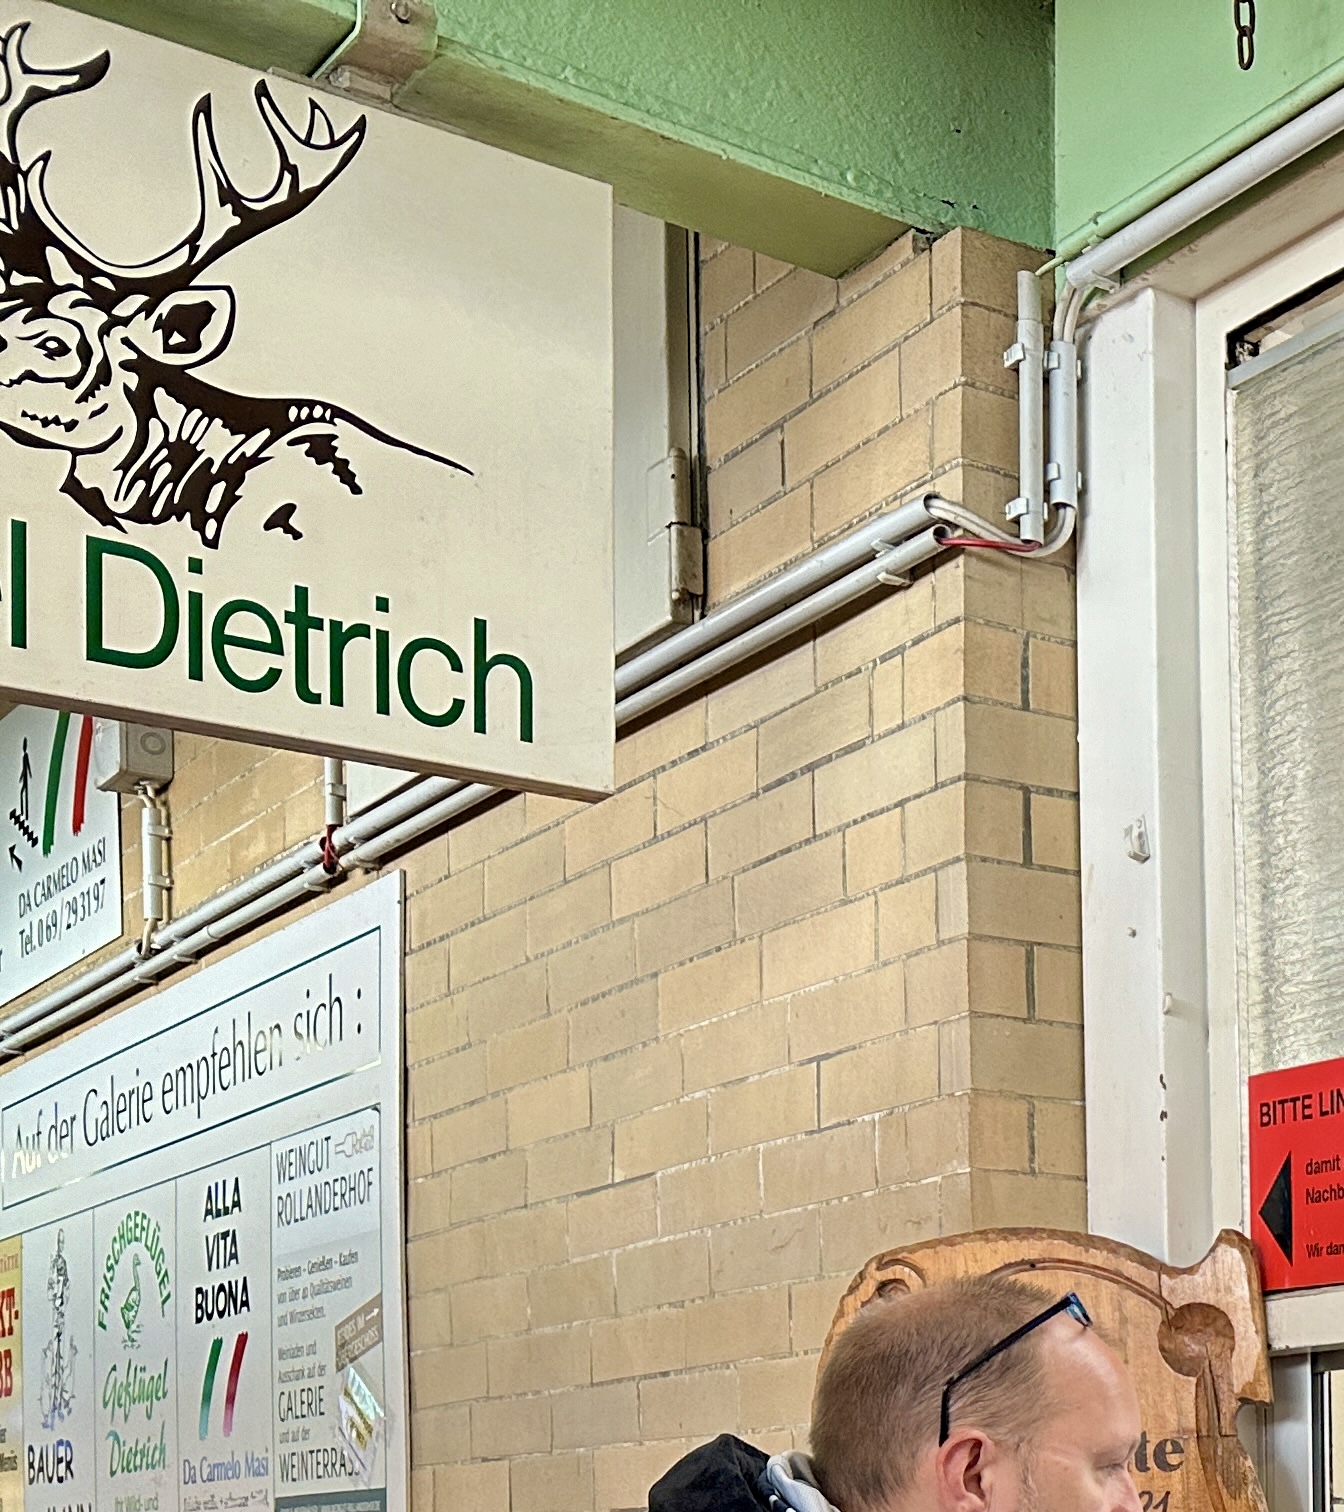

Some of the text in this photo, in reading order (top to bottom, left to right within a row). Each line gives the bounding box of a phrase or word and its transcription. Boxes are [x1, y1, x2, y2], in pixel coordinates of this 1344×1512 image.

[86, 534, 533, 744] Dietrich
[19, 836, 106, 918] DA CARMELO MASI
[19, 921, 36, 958] Tel.
[48, 1102, 76, 1164] der
[83, 1069, 154, 1147] Galerie
[162, 1012, 283, 1118] empfehlen
[1259, 1094, 1313, 1128] BITTE
[276, 1136, 332, 1184] WEINGUT
[1306, 1154, 1341, 1176] damit
[203, 1177, 242, 1223] ALLA
[277, 1168, 374, 1228] ROLLANDERHOF
[98, 1210, 171, 1331] FRISCHGEFLÜGEL
[205, 1228, 239, 1273] VITA
[1306, 1243, 1324, 1258] Wir
[195, 1276, 251, 1325] BUONA
[102, 1357, 168, 1424] Geflügel
[278, 1385, 325, 1423] GALERIE
[28, 1439, 74, 1486] BAUER
[105, 1420, 166, 1477] Dietrich
[183, 1447, 269, 1485] Da Carmelo Masi
